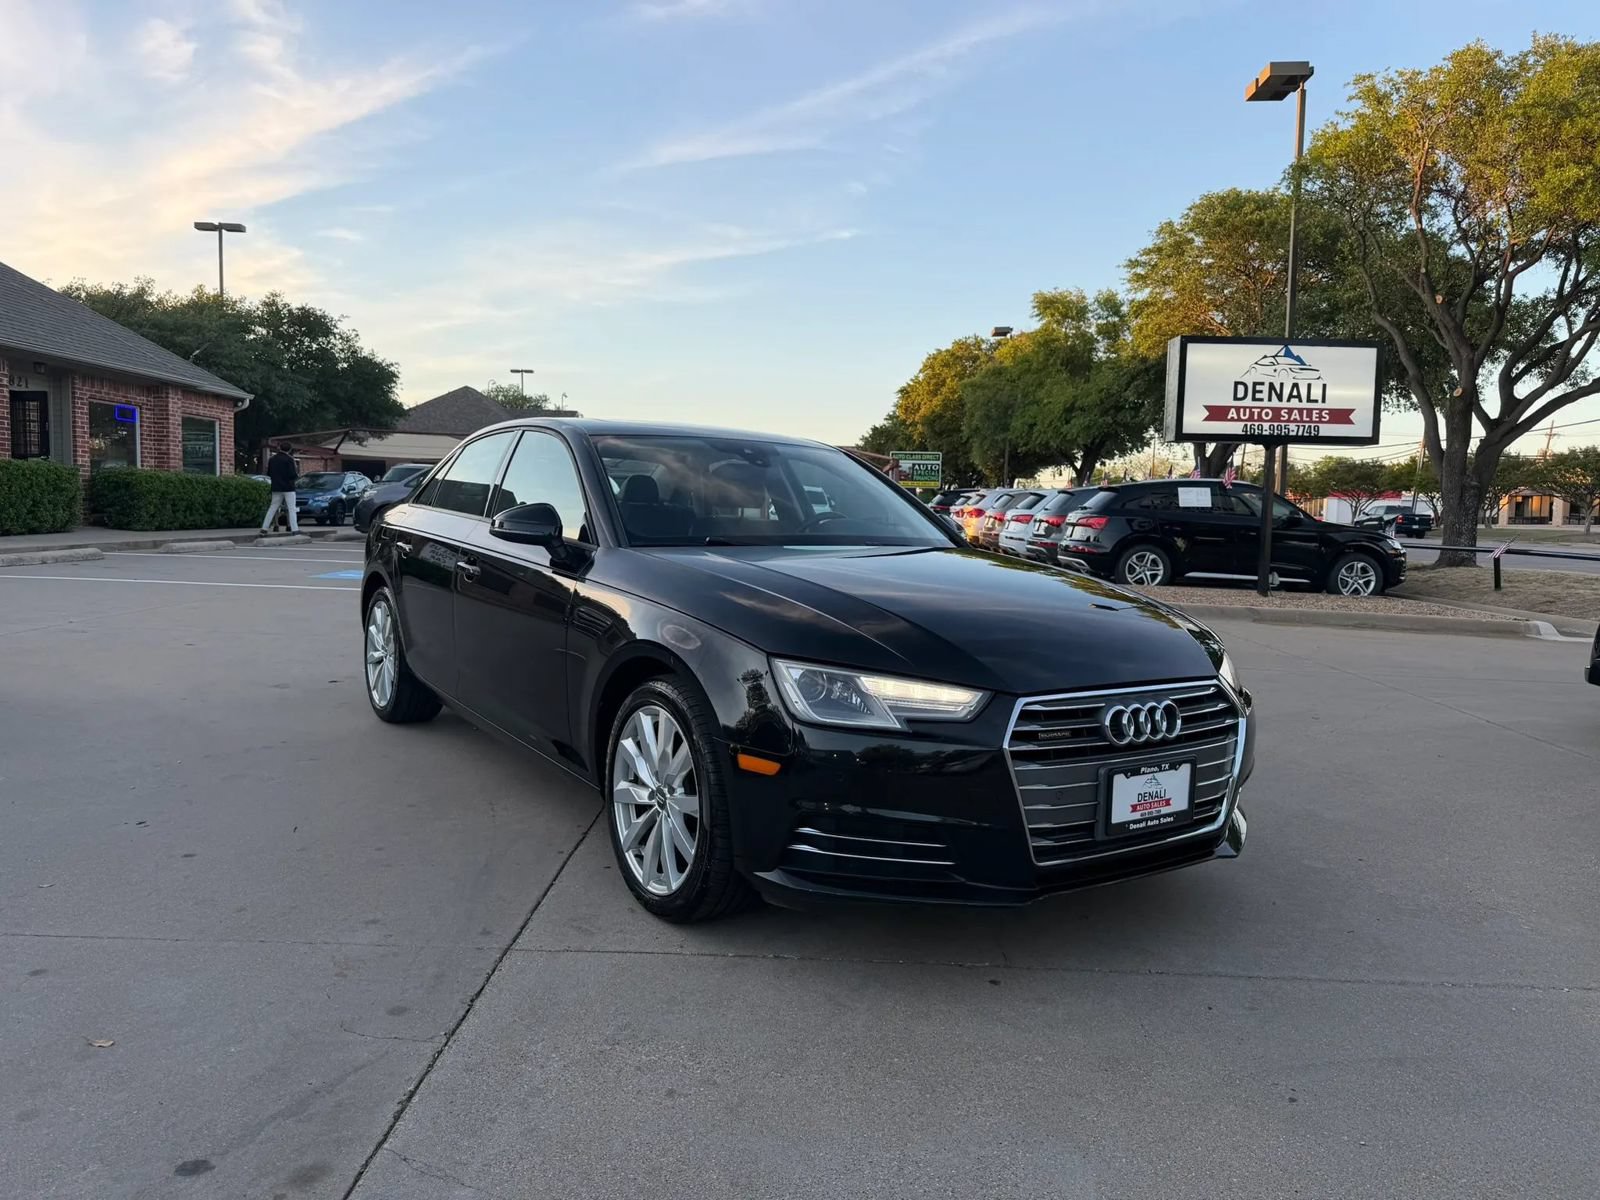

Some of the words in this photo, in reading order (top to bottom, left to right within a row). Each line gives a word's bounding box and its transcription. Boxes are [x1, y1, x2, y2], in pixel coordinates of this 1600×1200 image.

[1233, 381, 1327, 403] DENALI
[1227, 408, 1272, 421] AUTO
[1280, 409, 1330, 422] SALES
[1241, 424, 1320, 437] 469-995-7749
[1161, 763, 1170, 771] TX
[1137, 789, 1167, 802] DENALI
[1136, 803, 1151, 811] AUTO
[1151, 800, 1166, 808] SALES
[1129, 821, 1147, 830] Denali
[1160, 816, 1174, 824] Sales
